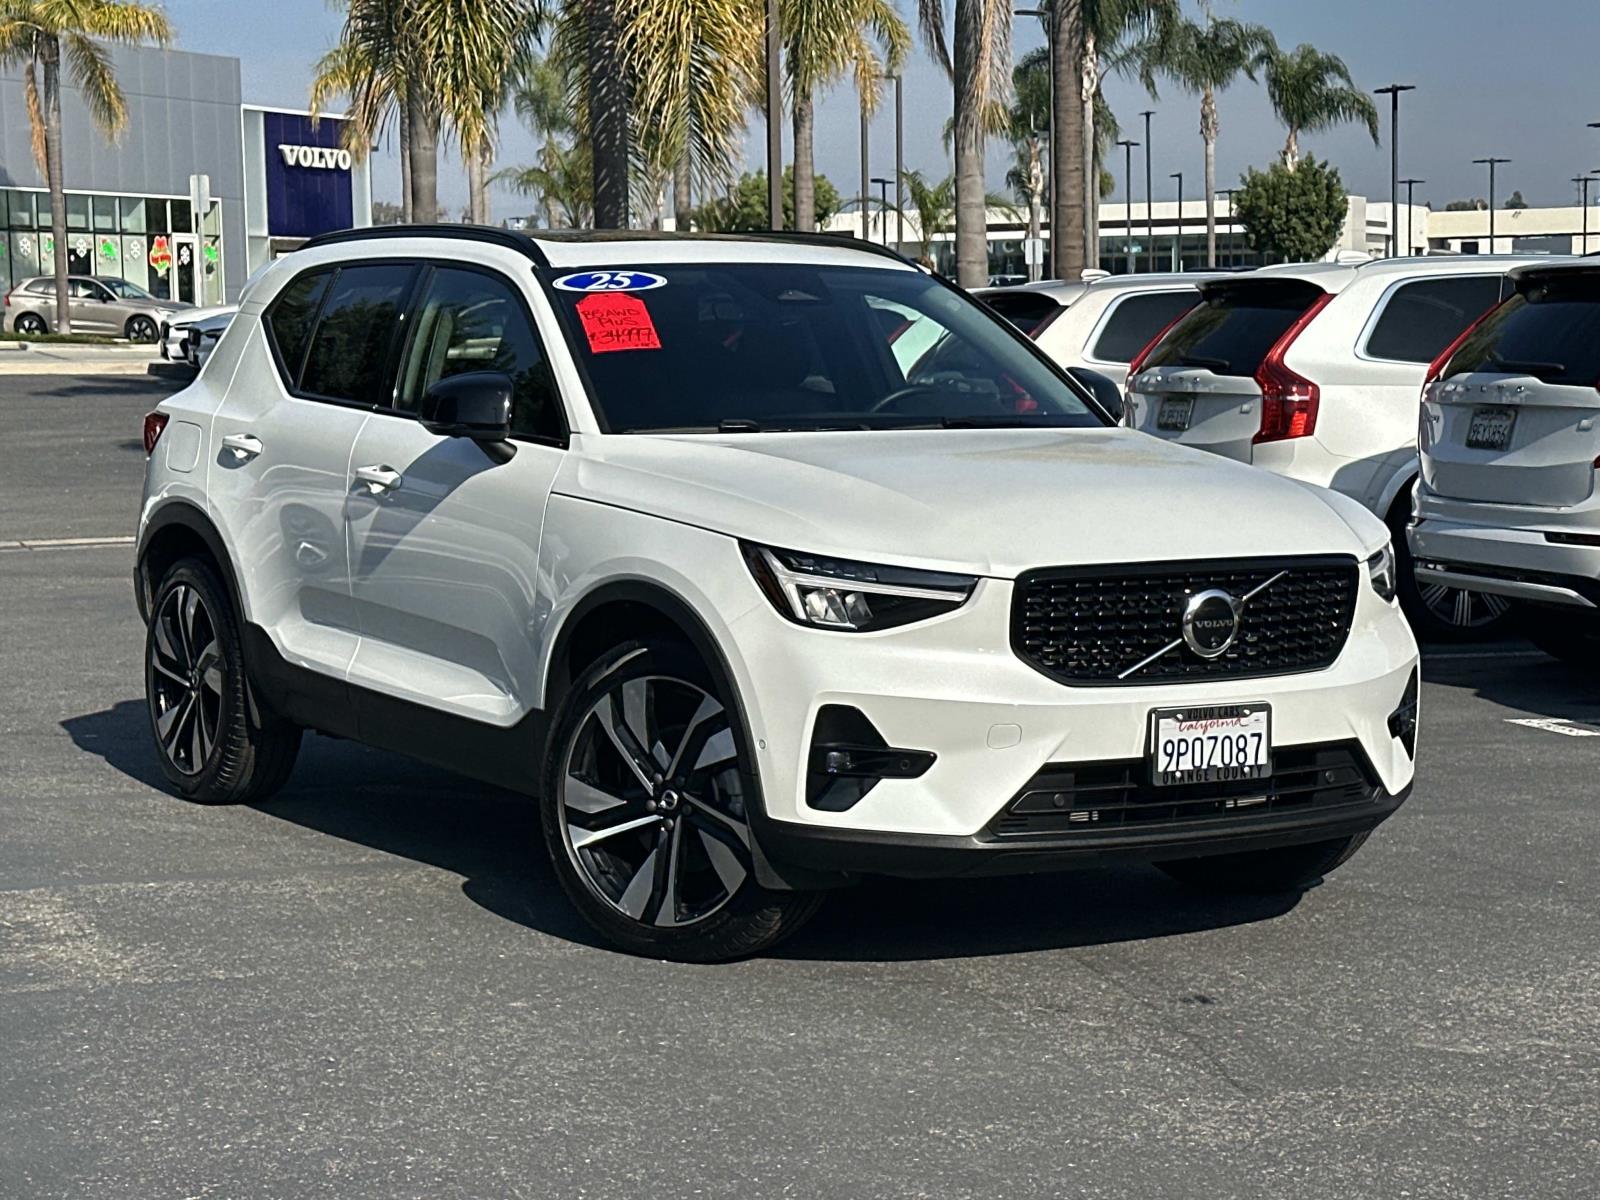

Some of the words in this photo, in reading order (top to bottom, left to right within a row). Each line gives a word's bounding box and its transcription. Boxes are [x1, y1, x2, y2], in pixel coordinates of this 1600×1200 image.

[278, 144, 351, 170] VOLVO
[586, 273, 632, 290] 25
[1194, 620, 1234, 629] VOLVO
[1187, 707, 1214, 720] VOLVO
[1162, 767, 1210, 785] ORANGE
[1216, 763, 1264, 780] COUNTY
